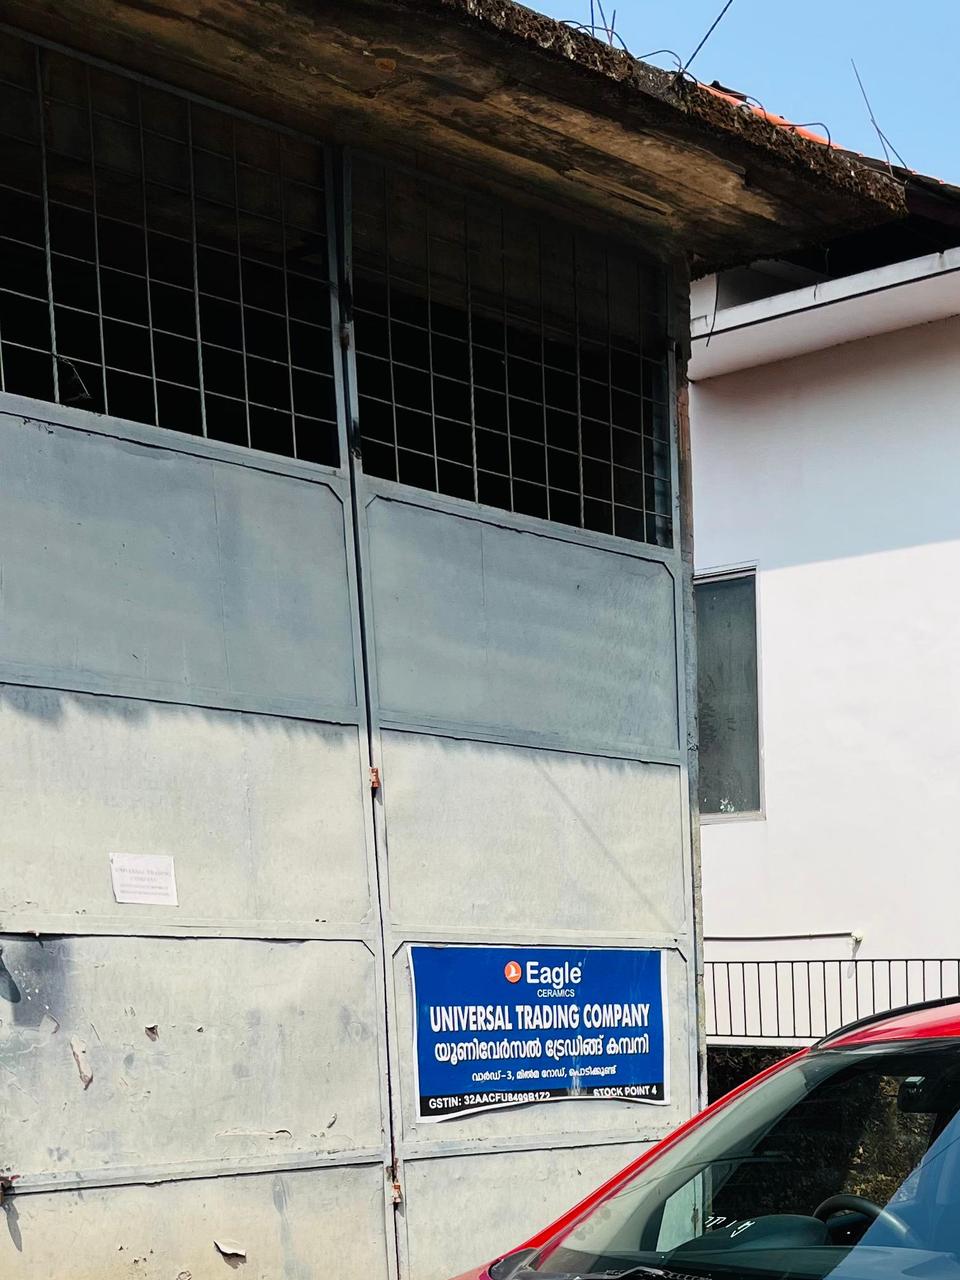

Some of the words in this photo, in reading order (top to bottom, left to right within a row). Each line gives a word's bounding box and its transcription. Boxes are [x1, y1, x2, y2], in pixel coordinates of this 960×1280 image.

[526, 961, 582, 989] Eagle
[537, 988, 575, 998] CERAMICS
[430, 1006, 513, 1032] UNIVERSAL
[516, 1004, 579, 1030] TRADING
[583, 1003, 650, 1029] COMPANY
[428, 1096, 462, 1110] GSTIN:
[593, 1087, 624, 1097] STOCK
[624, 1085, 651, 1096] POINT
[651, 1085, 658, 1095] 4
